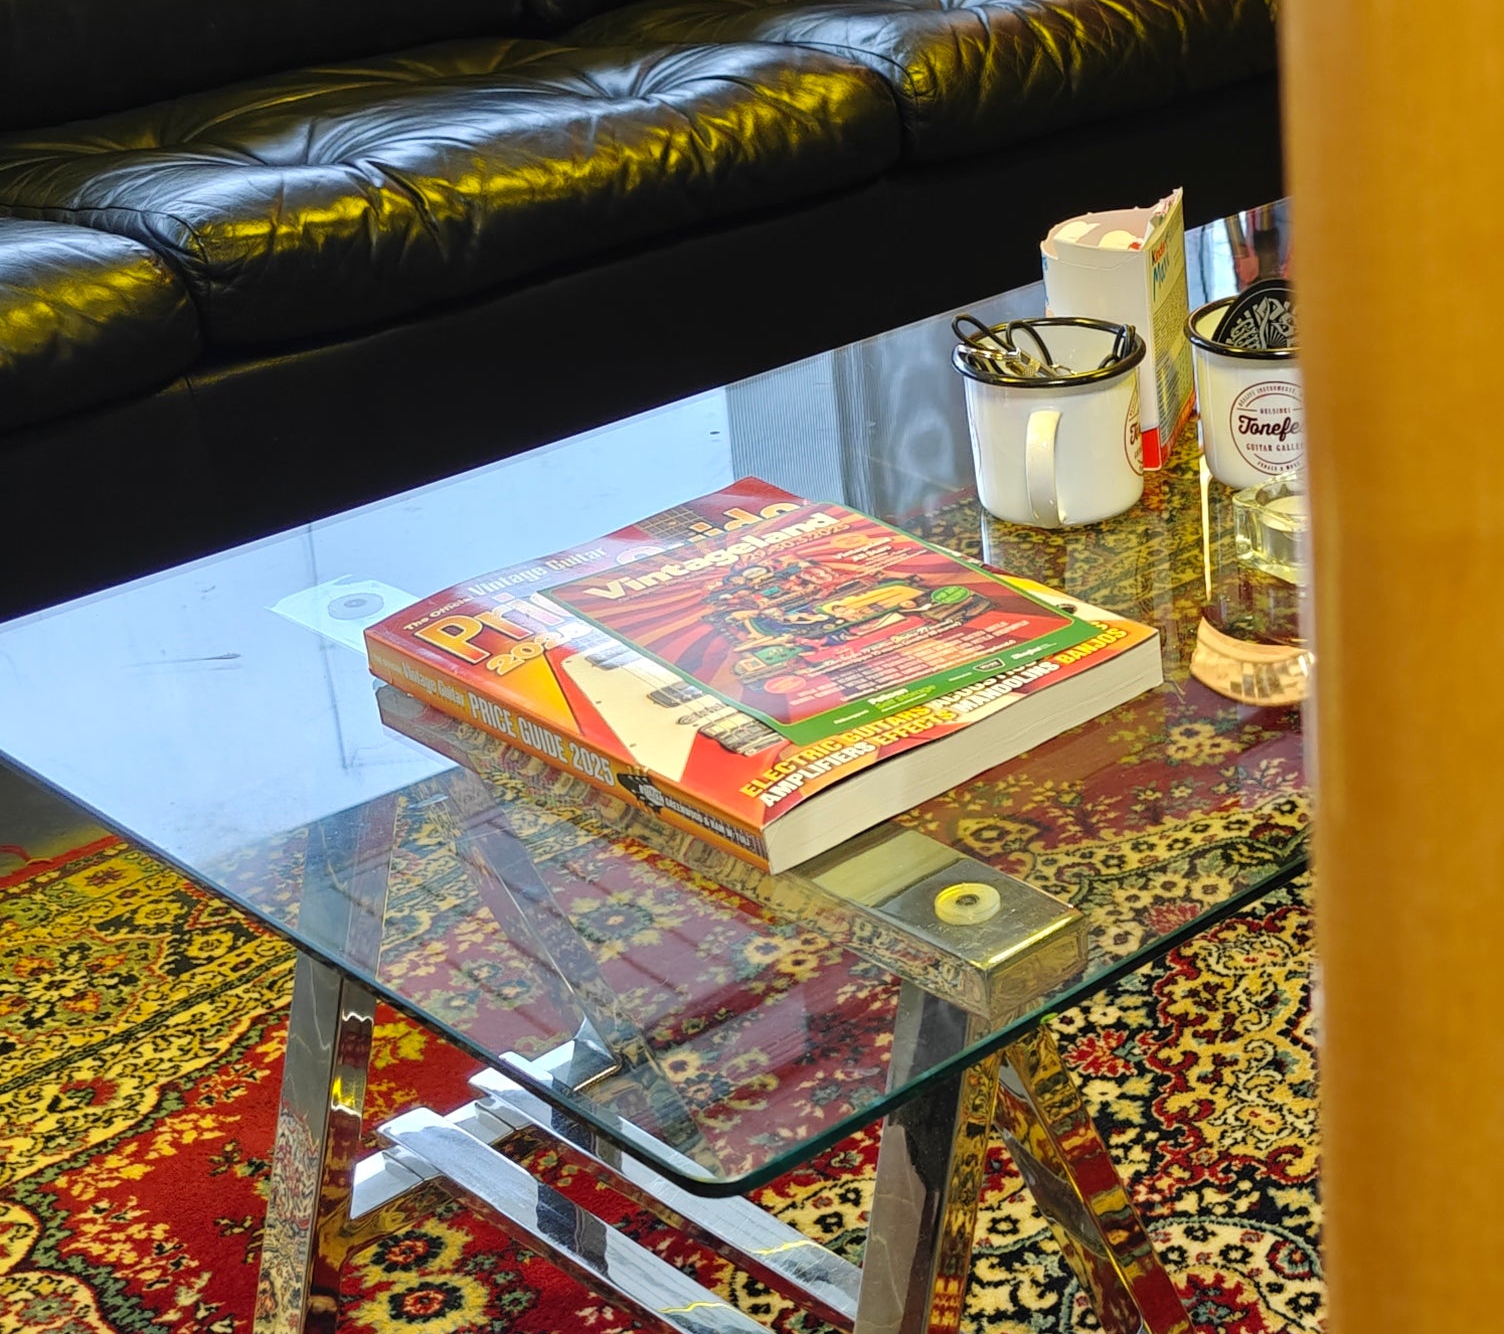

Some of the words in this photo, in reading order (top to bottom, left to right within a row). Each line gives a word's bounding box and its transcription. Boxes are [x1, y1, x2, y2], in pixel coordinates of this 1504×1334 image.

[1238, 414, 1303, 442] Tonefe
[404, 616, 430, 631] The
[467, 565, 549, 596] Vintage
[545, 546, 607, 573] Guitar
[583, 512, 840, 602] Vintageland
[466, 690, 518, 739] PRICE
[516, 715, 569, 764] GUIDE
[568, 741, 617, 787] 2025
[741, 737, 844, 799] ELECTRIC
[842, 701, 932, 744] GUITARS
[759, 740, 877, 808] AMPLIFIERS
[874, 706, 958, 746] EFFECTS
[954, 660, 1061, 714] MANDOLINS
[1056, 627, 1129, 666] BANJOS
